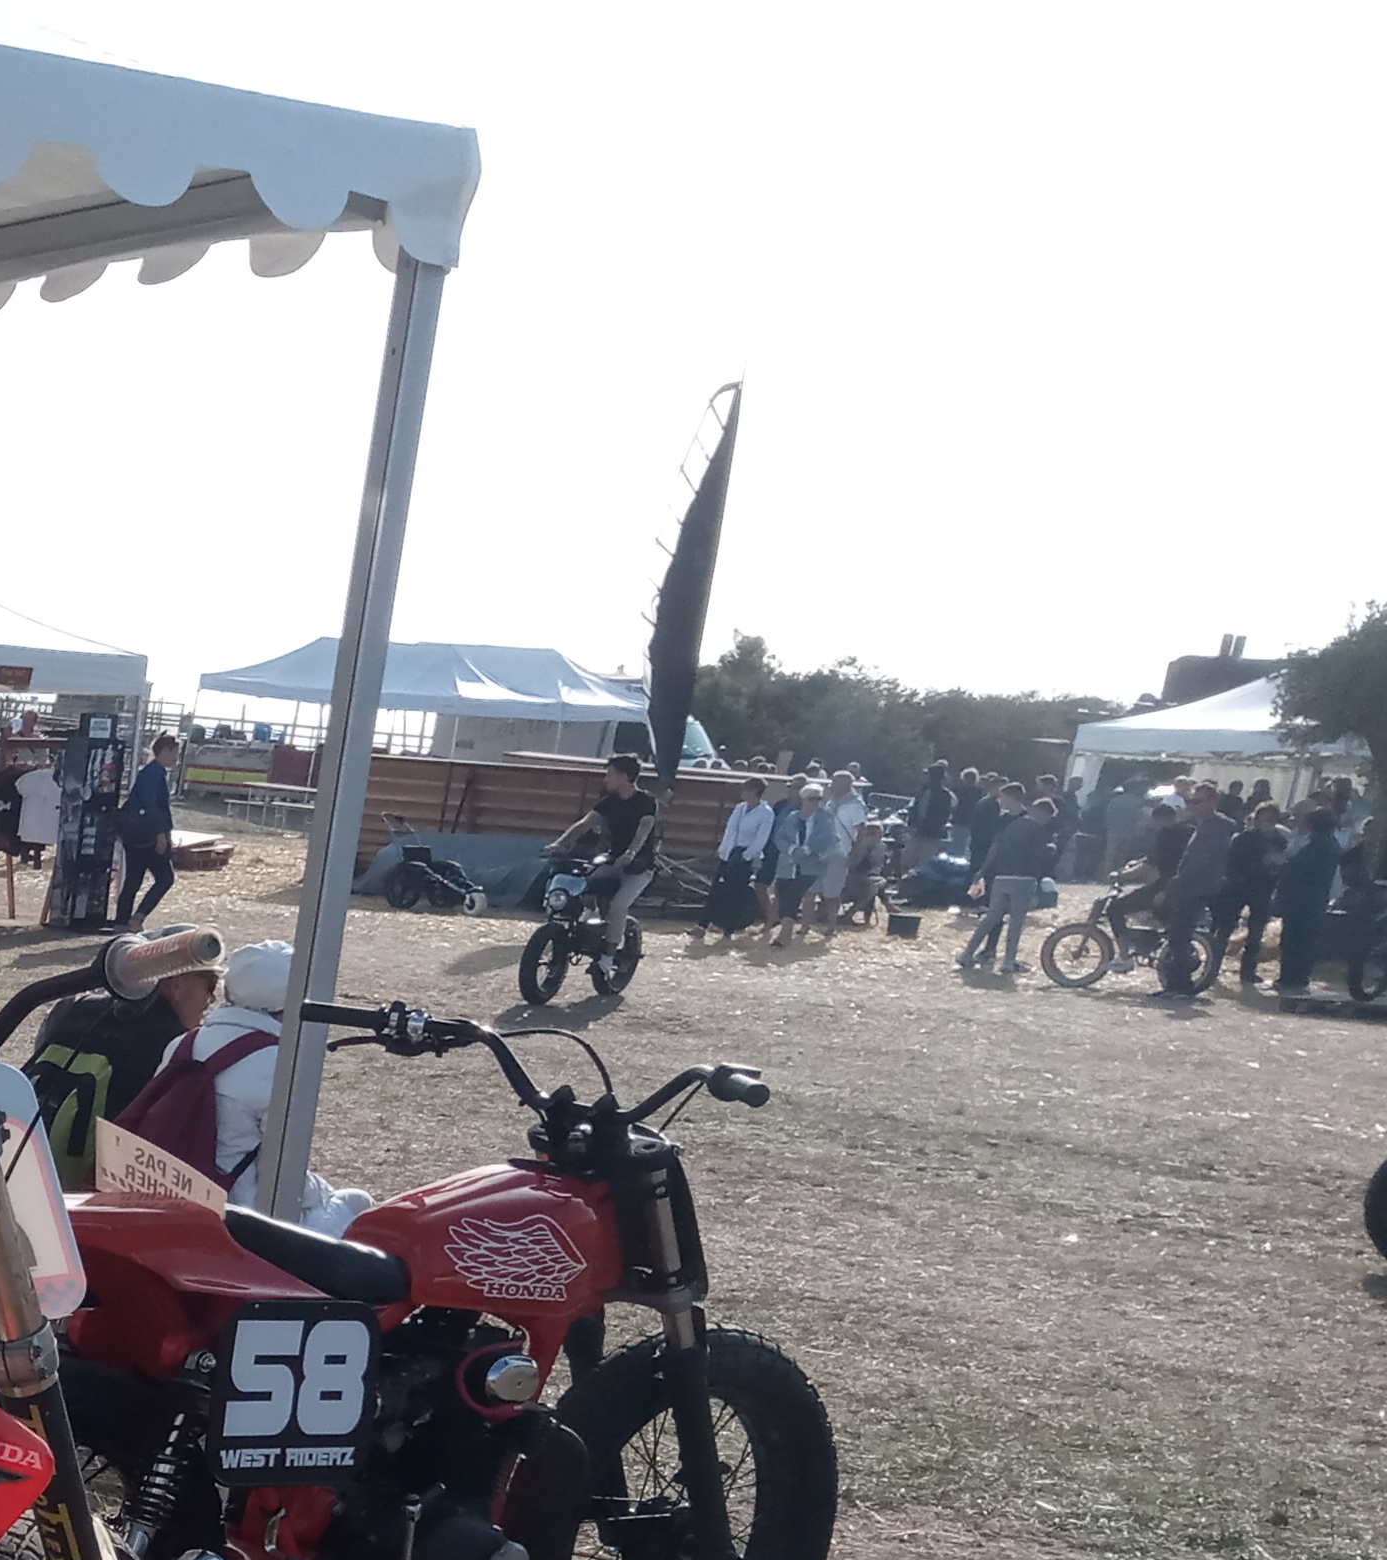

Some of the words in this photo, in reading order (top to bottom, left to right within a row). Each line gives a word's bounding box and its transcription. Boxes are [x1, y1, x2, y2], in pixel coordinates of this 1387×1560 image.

[484, 1281, 567, 1300] HONDA
[222, 1320, 370, 1437] 58
[220, 1448, 281, 1470] WEST
[285, 1446, 356, 1467] RIDERZ
